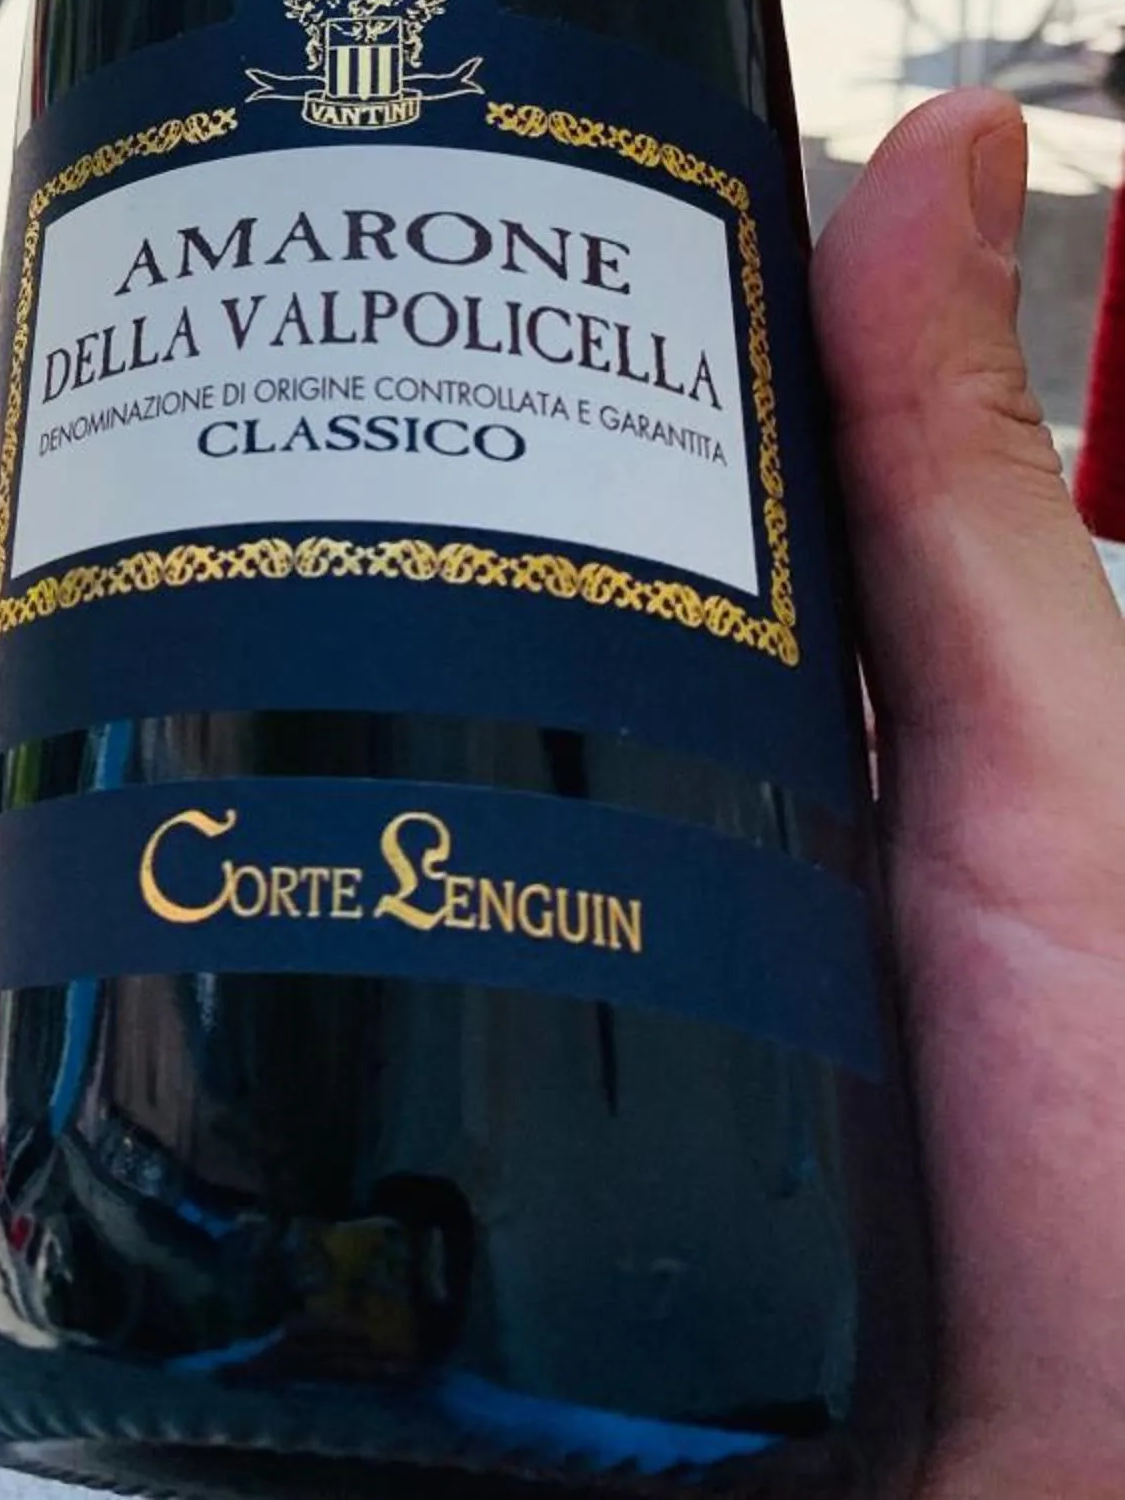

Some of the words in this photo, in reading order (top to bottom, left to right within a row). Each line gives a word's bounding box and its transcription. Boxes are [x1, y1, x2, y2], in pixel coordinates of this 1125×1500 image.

[310, 100, 415, 125] VANTINI
[113, 209, 631, 297] AMARONE
[42, 306, 201, 405] DELLA
[221, 289, 723, 411] VALPOLICELLA
[39, 385, 215, 457] DENOMINAZIONE
[222, 382, 246, 407] DI
[254, 376, 365, 403] ORIGINE
[374, 375, 570, 421] CONTROLLATA
[578, 400, 592, 425] E
[599, 405, 728, 466] GARANTITA
[197, 414, 526, 462] CLASSICO
[139, 808, 364, 923] CORTE
[373, 811, 643, 953] LENGUIN
